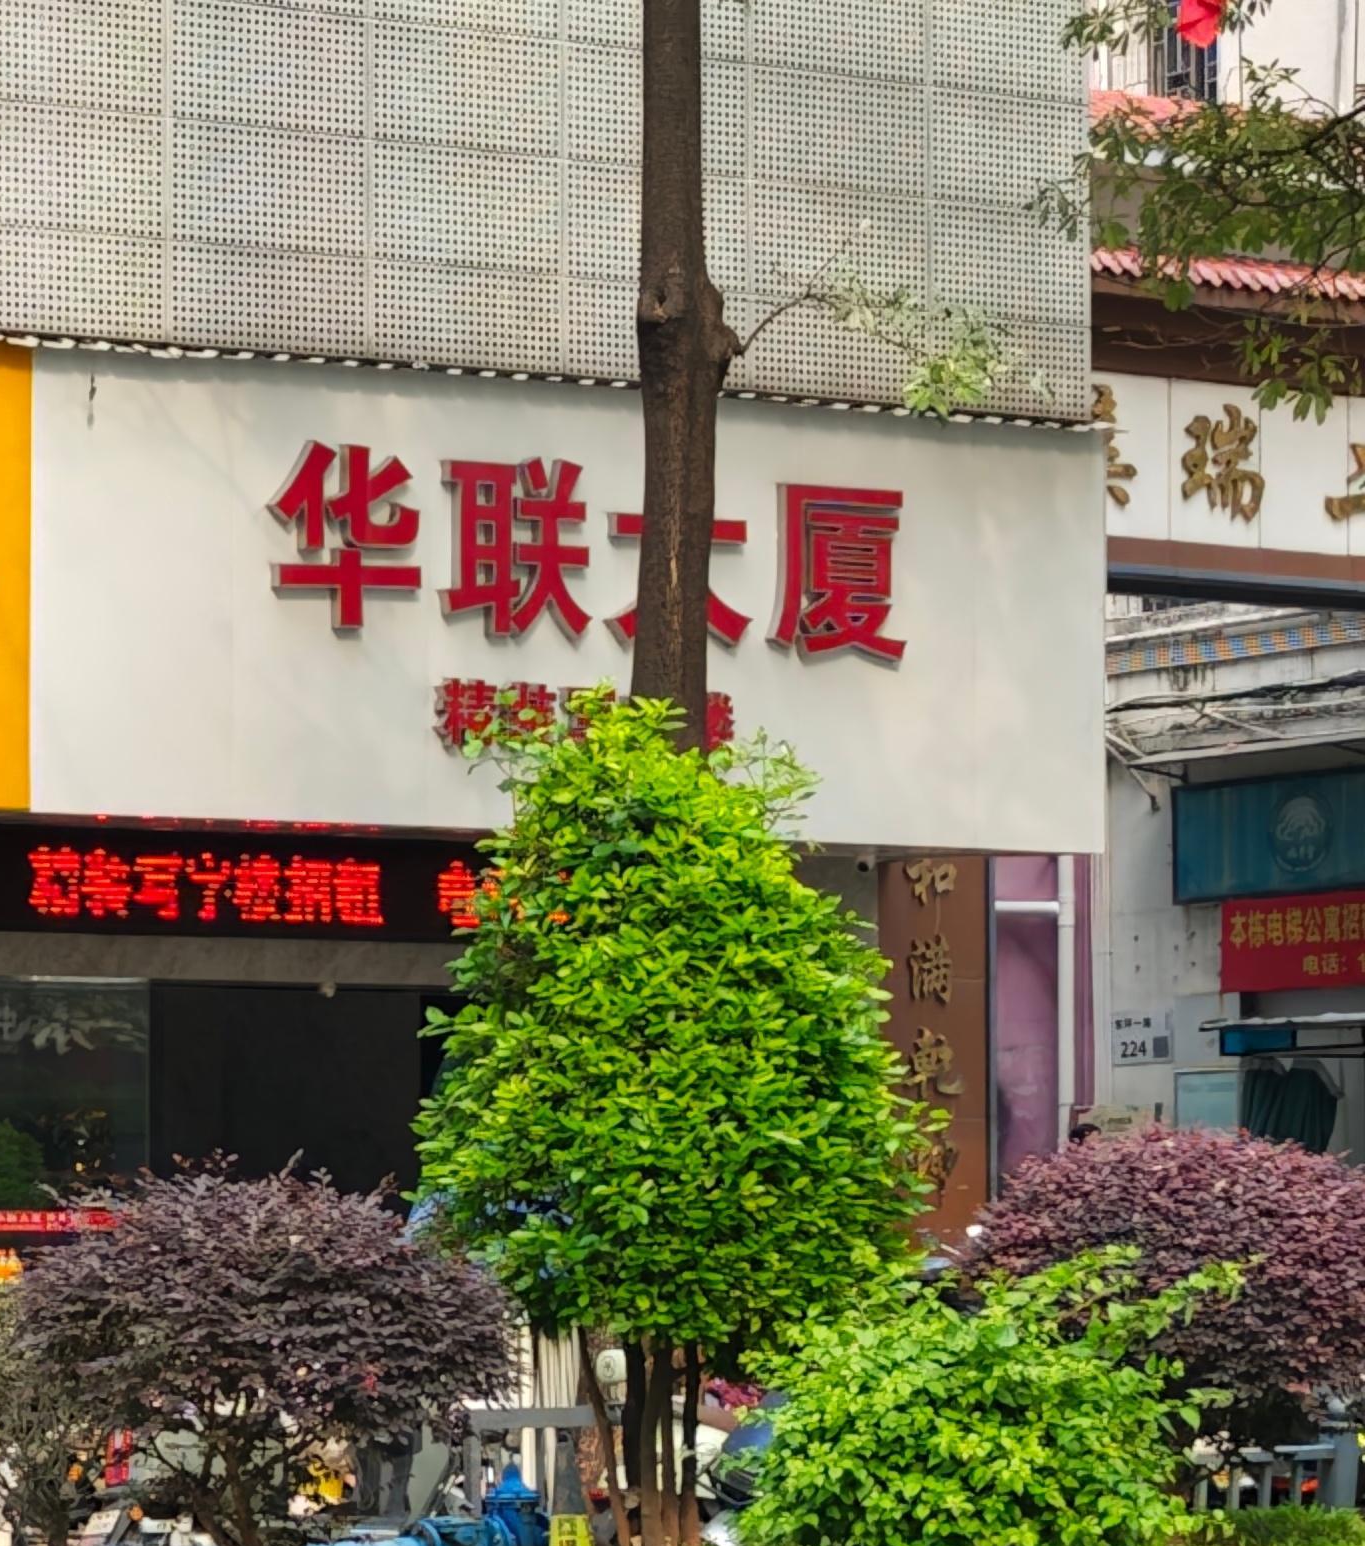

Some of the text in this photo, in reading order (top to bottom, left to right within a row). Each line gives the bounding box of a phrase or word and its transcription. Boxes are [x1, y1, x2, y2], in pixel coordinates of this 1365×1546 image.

[1229, 902, 1365, 951] 本栋电梯公寓招
[1120, 1040, 1147, 1058] 224
